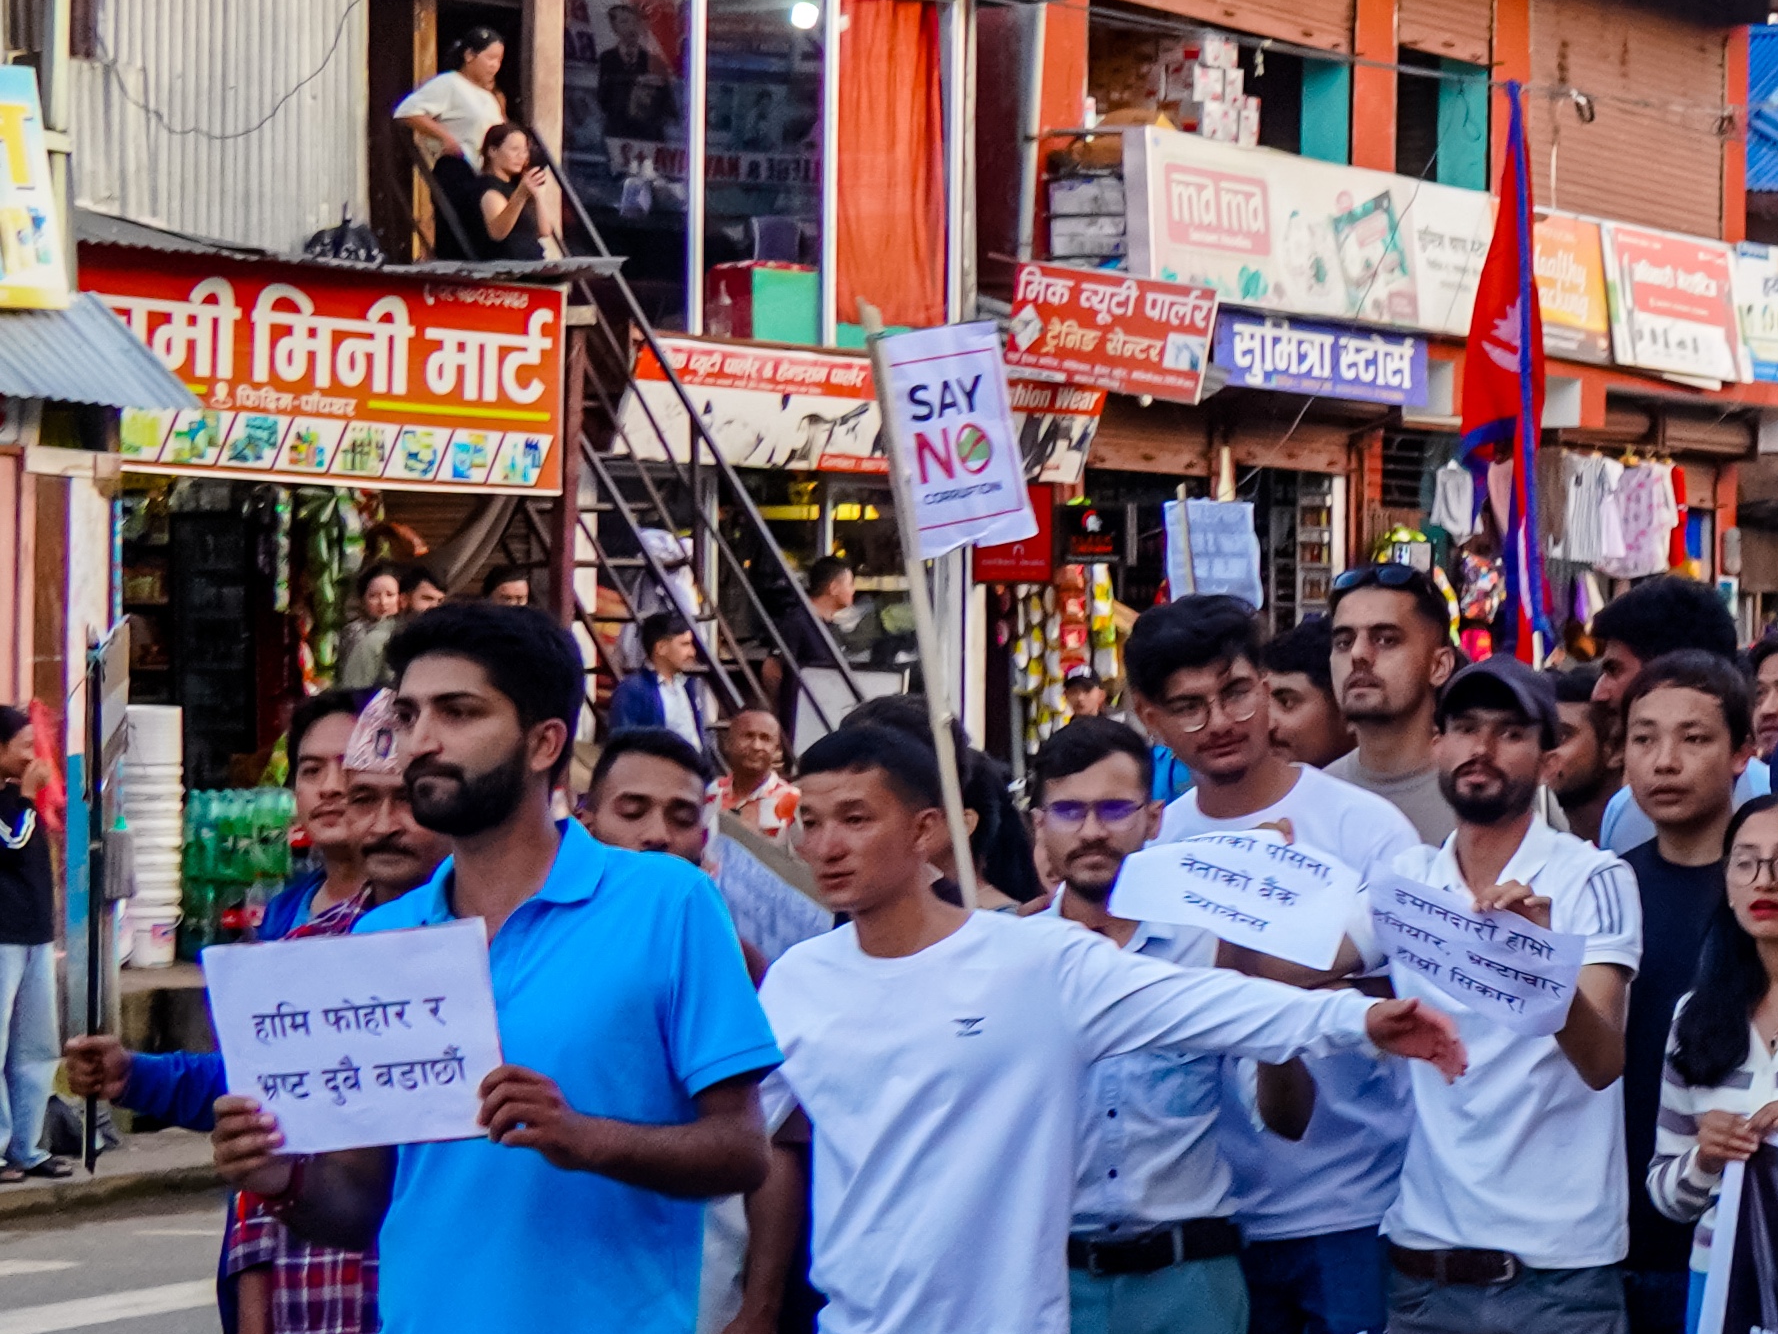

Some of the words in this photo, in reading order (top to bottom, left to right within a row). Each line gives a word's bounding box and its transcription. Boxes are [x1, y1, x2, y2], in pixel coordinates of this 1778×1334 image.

[1017, 266, 1075, 305] मिक
[250, 282, 416, 395] मिनी
[425, 307, 554, 405] मार्ट
[908, 374, 982, 422] SAY
[1055, 386, 1101, 410] Wear
[913, 423, 993, 485] NO
[924, 480, 1003, 506] CORRUPTION
[423, 996, 447, 1026] र
